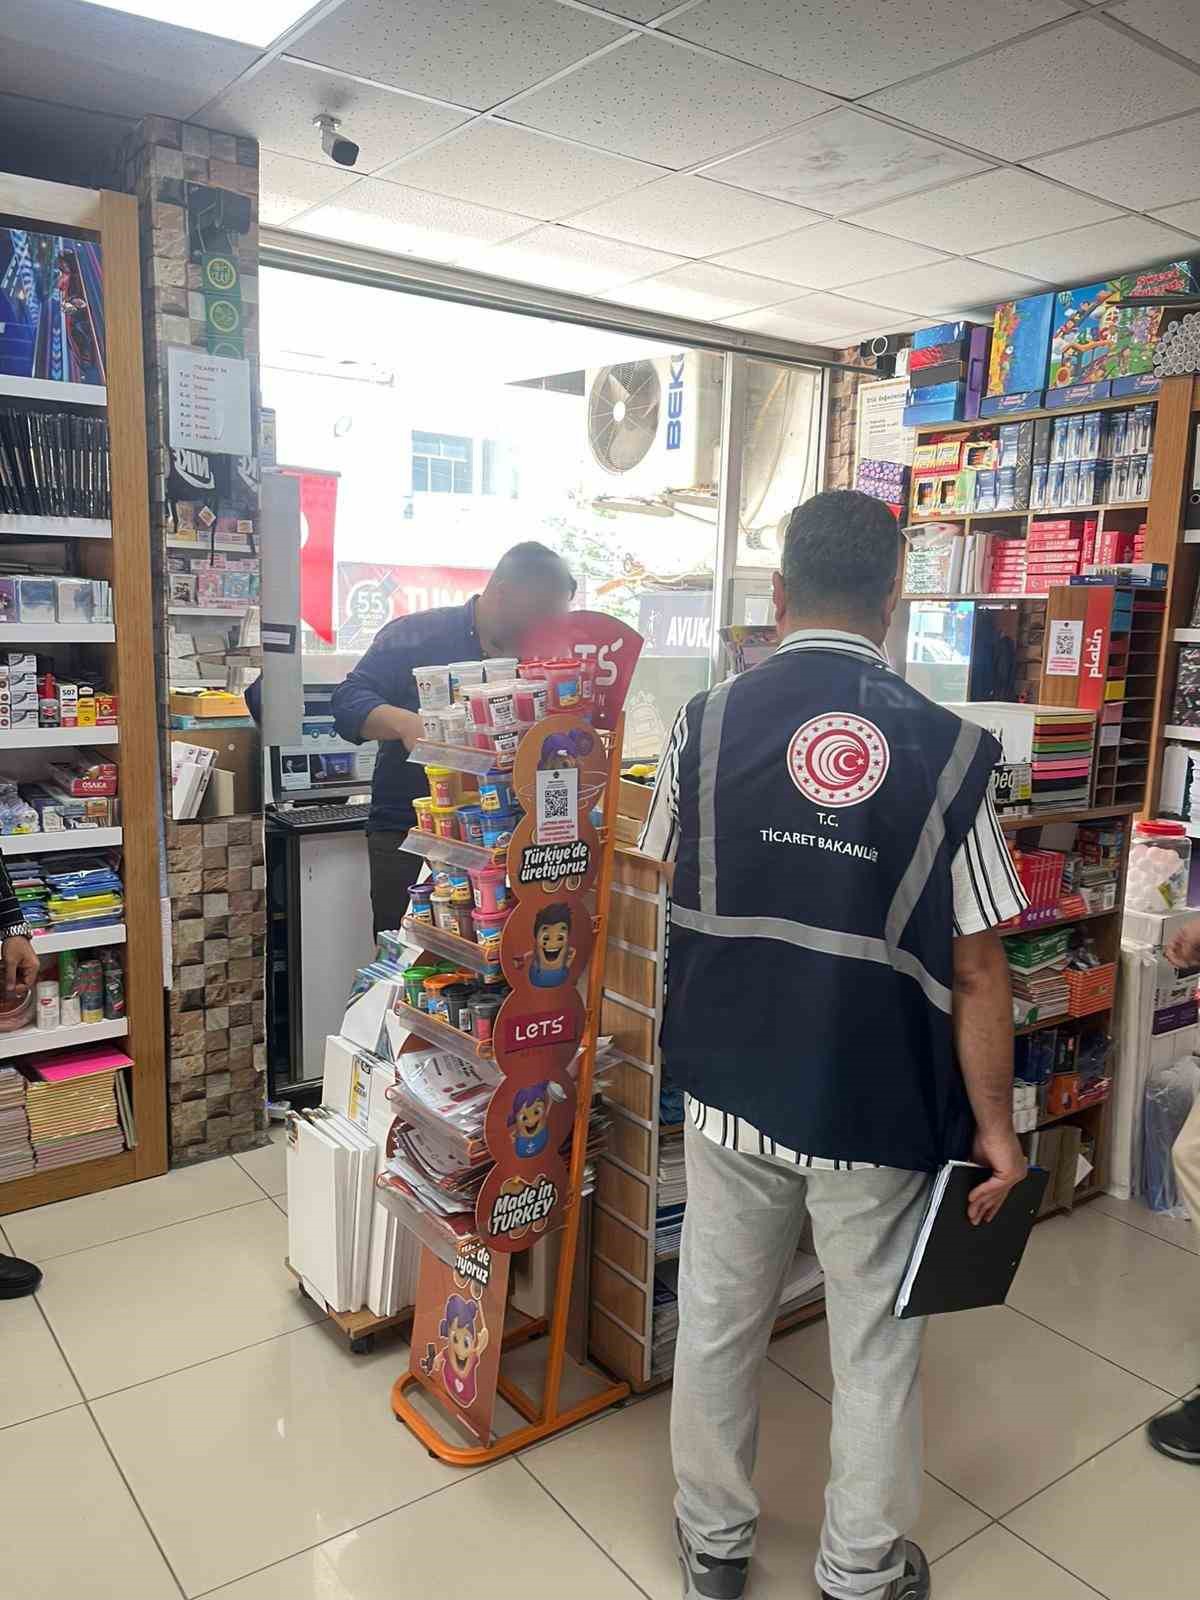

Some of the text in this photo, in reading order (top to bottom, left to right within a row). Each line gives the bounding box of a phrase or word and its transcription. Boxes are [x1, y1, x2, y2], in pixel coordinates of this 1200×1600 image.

[666, 353, 685, 449] BEK
[1084, 629, 1103, 678] platin
[816, 812, 839, 827] T.C.
[760, 827, 815, 846] TİCARET
[524, 842, 588, 865] Türkiye'de
[521, 860, 587, 880] üretiyoruz
[493, 1180, 553, 1216] Made in
[492, 1197, 554, 1235] TURKEY
